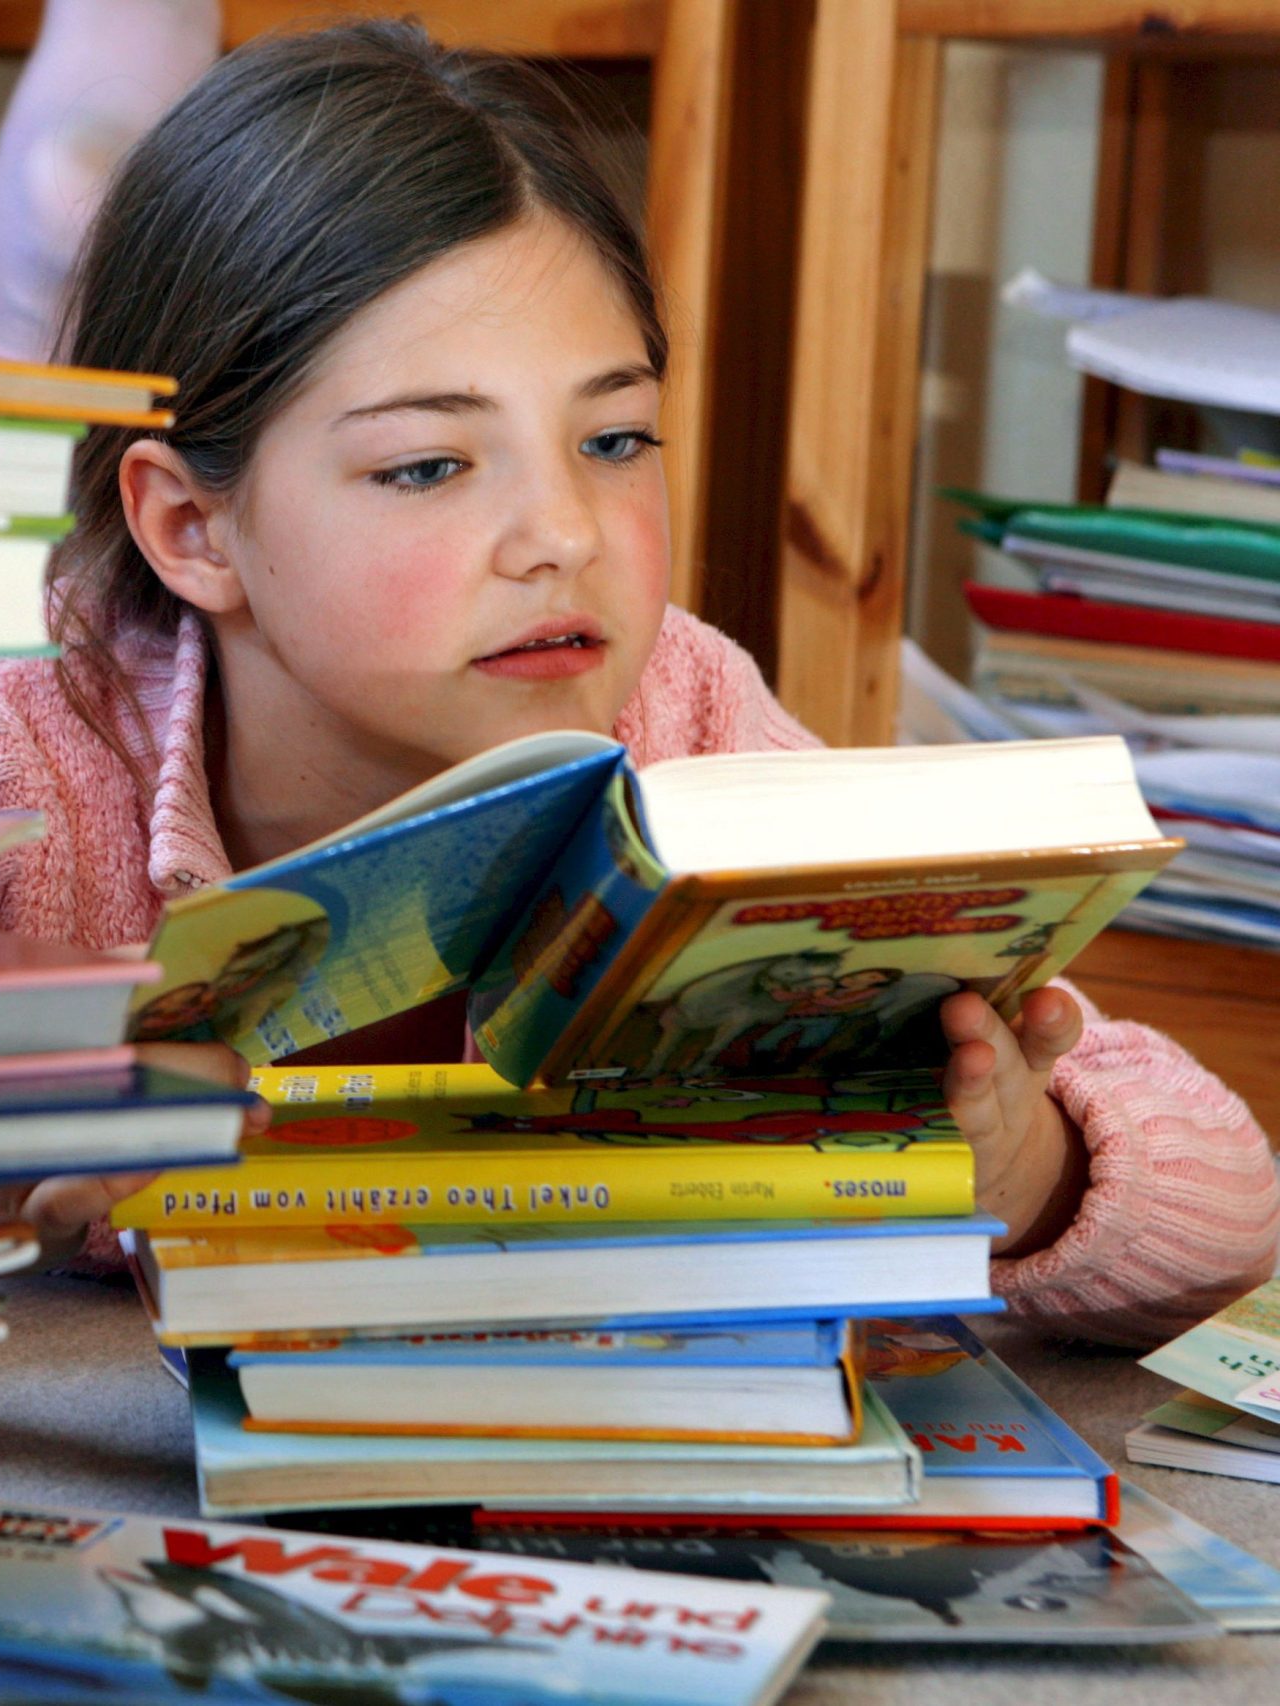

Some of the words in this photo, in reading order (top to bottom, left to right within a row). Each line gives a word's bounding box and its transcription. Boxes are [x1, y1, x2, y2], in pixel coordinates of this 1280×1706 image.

[250, 1189, 307, 1208] vom
[324, 1187, 430, 1214] erzählt
[446, 1186, 515, 1212] Theo
[529, 1183, 611, 1211] Onkel
[730, 1181, 775, 1199] Martin
[824, 1178, 906, 1198] moses.
[163, 1189, 238, 1216] Pferd
[164, 1527, 556, 1606] Wale
[585, 1595, 761, 1635] und
[341, 1586, 745, 1660] Delphine
